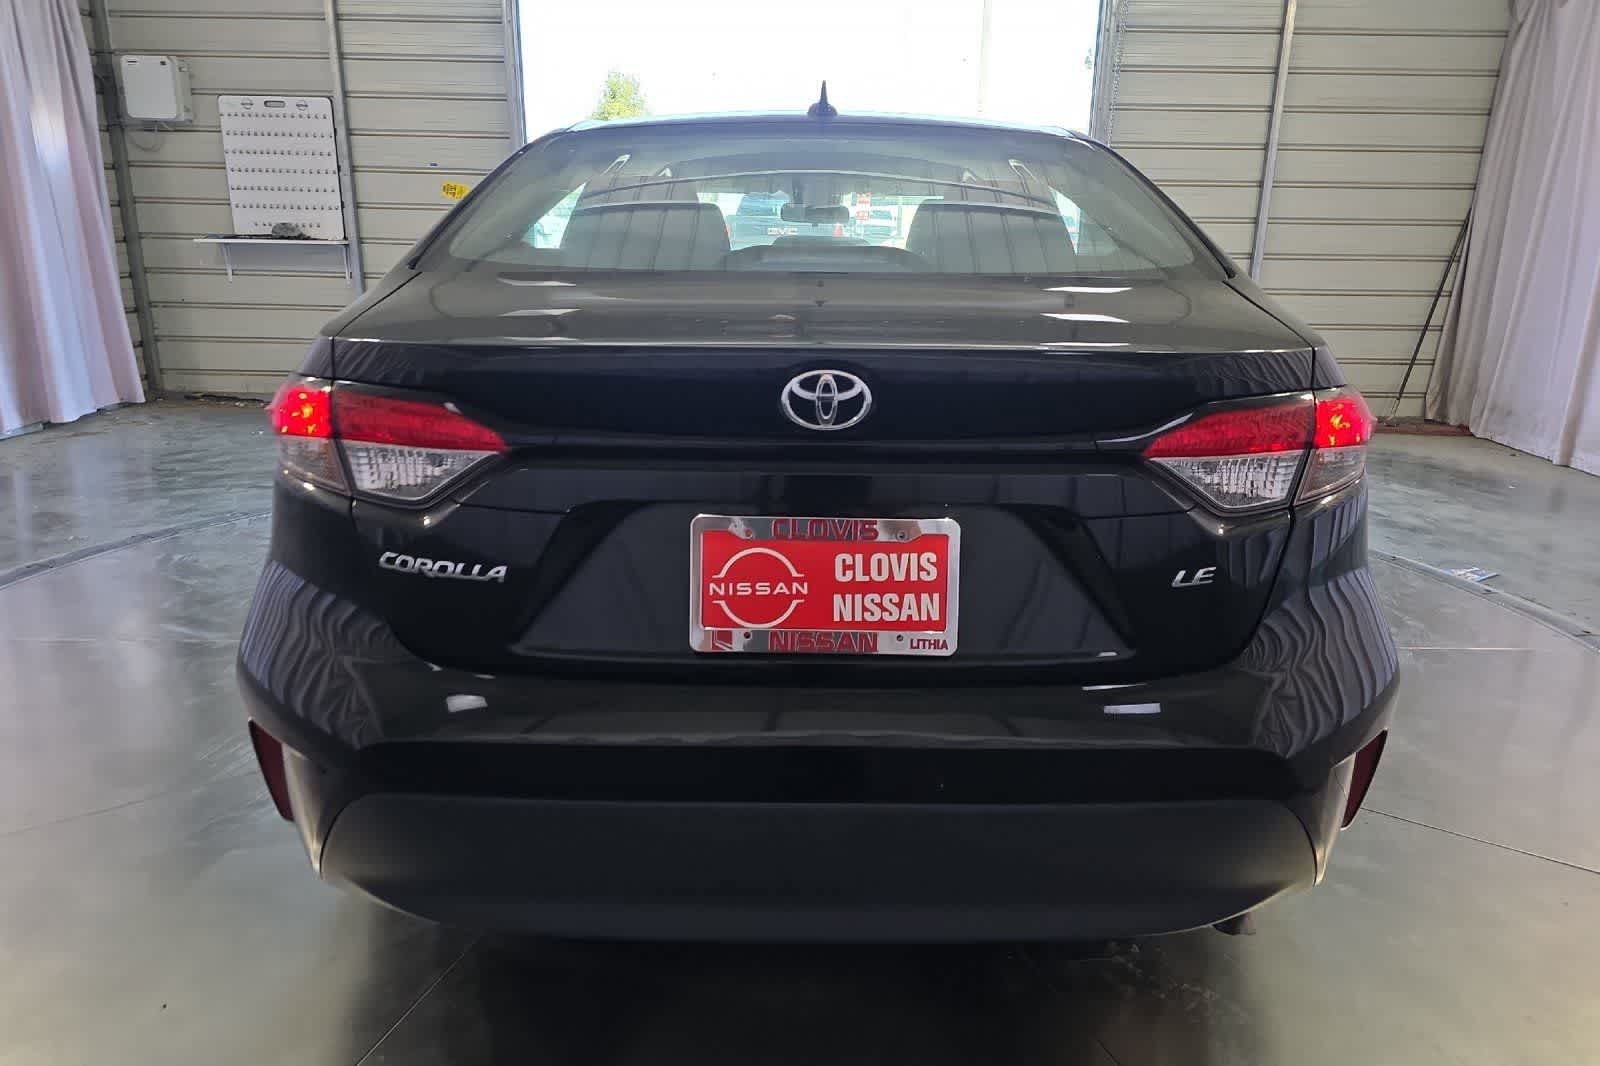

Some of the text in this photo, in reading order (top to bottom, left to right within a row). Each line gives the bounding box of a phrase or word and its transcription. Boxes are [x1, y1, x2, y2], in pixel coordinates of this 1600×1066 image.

[771, 518, 879, 541] CLOVIS
[379, 551, 508, 583] COROLLA
[833, 552, 938, 582] CLOVIS
[1171, 566, 1217, 587] LE
[708, 582, 809, 596] NISSAN
[832, 593, 940, 622] NISSAN
[767, 631, 879, 652] NISSAN
[910, 638, 949, 651] LITHIA
